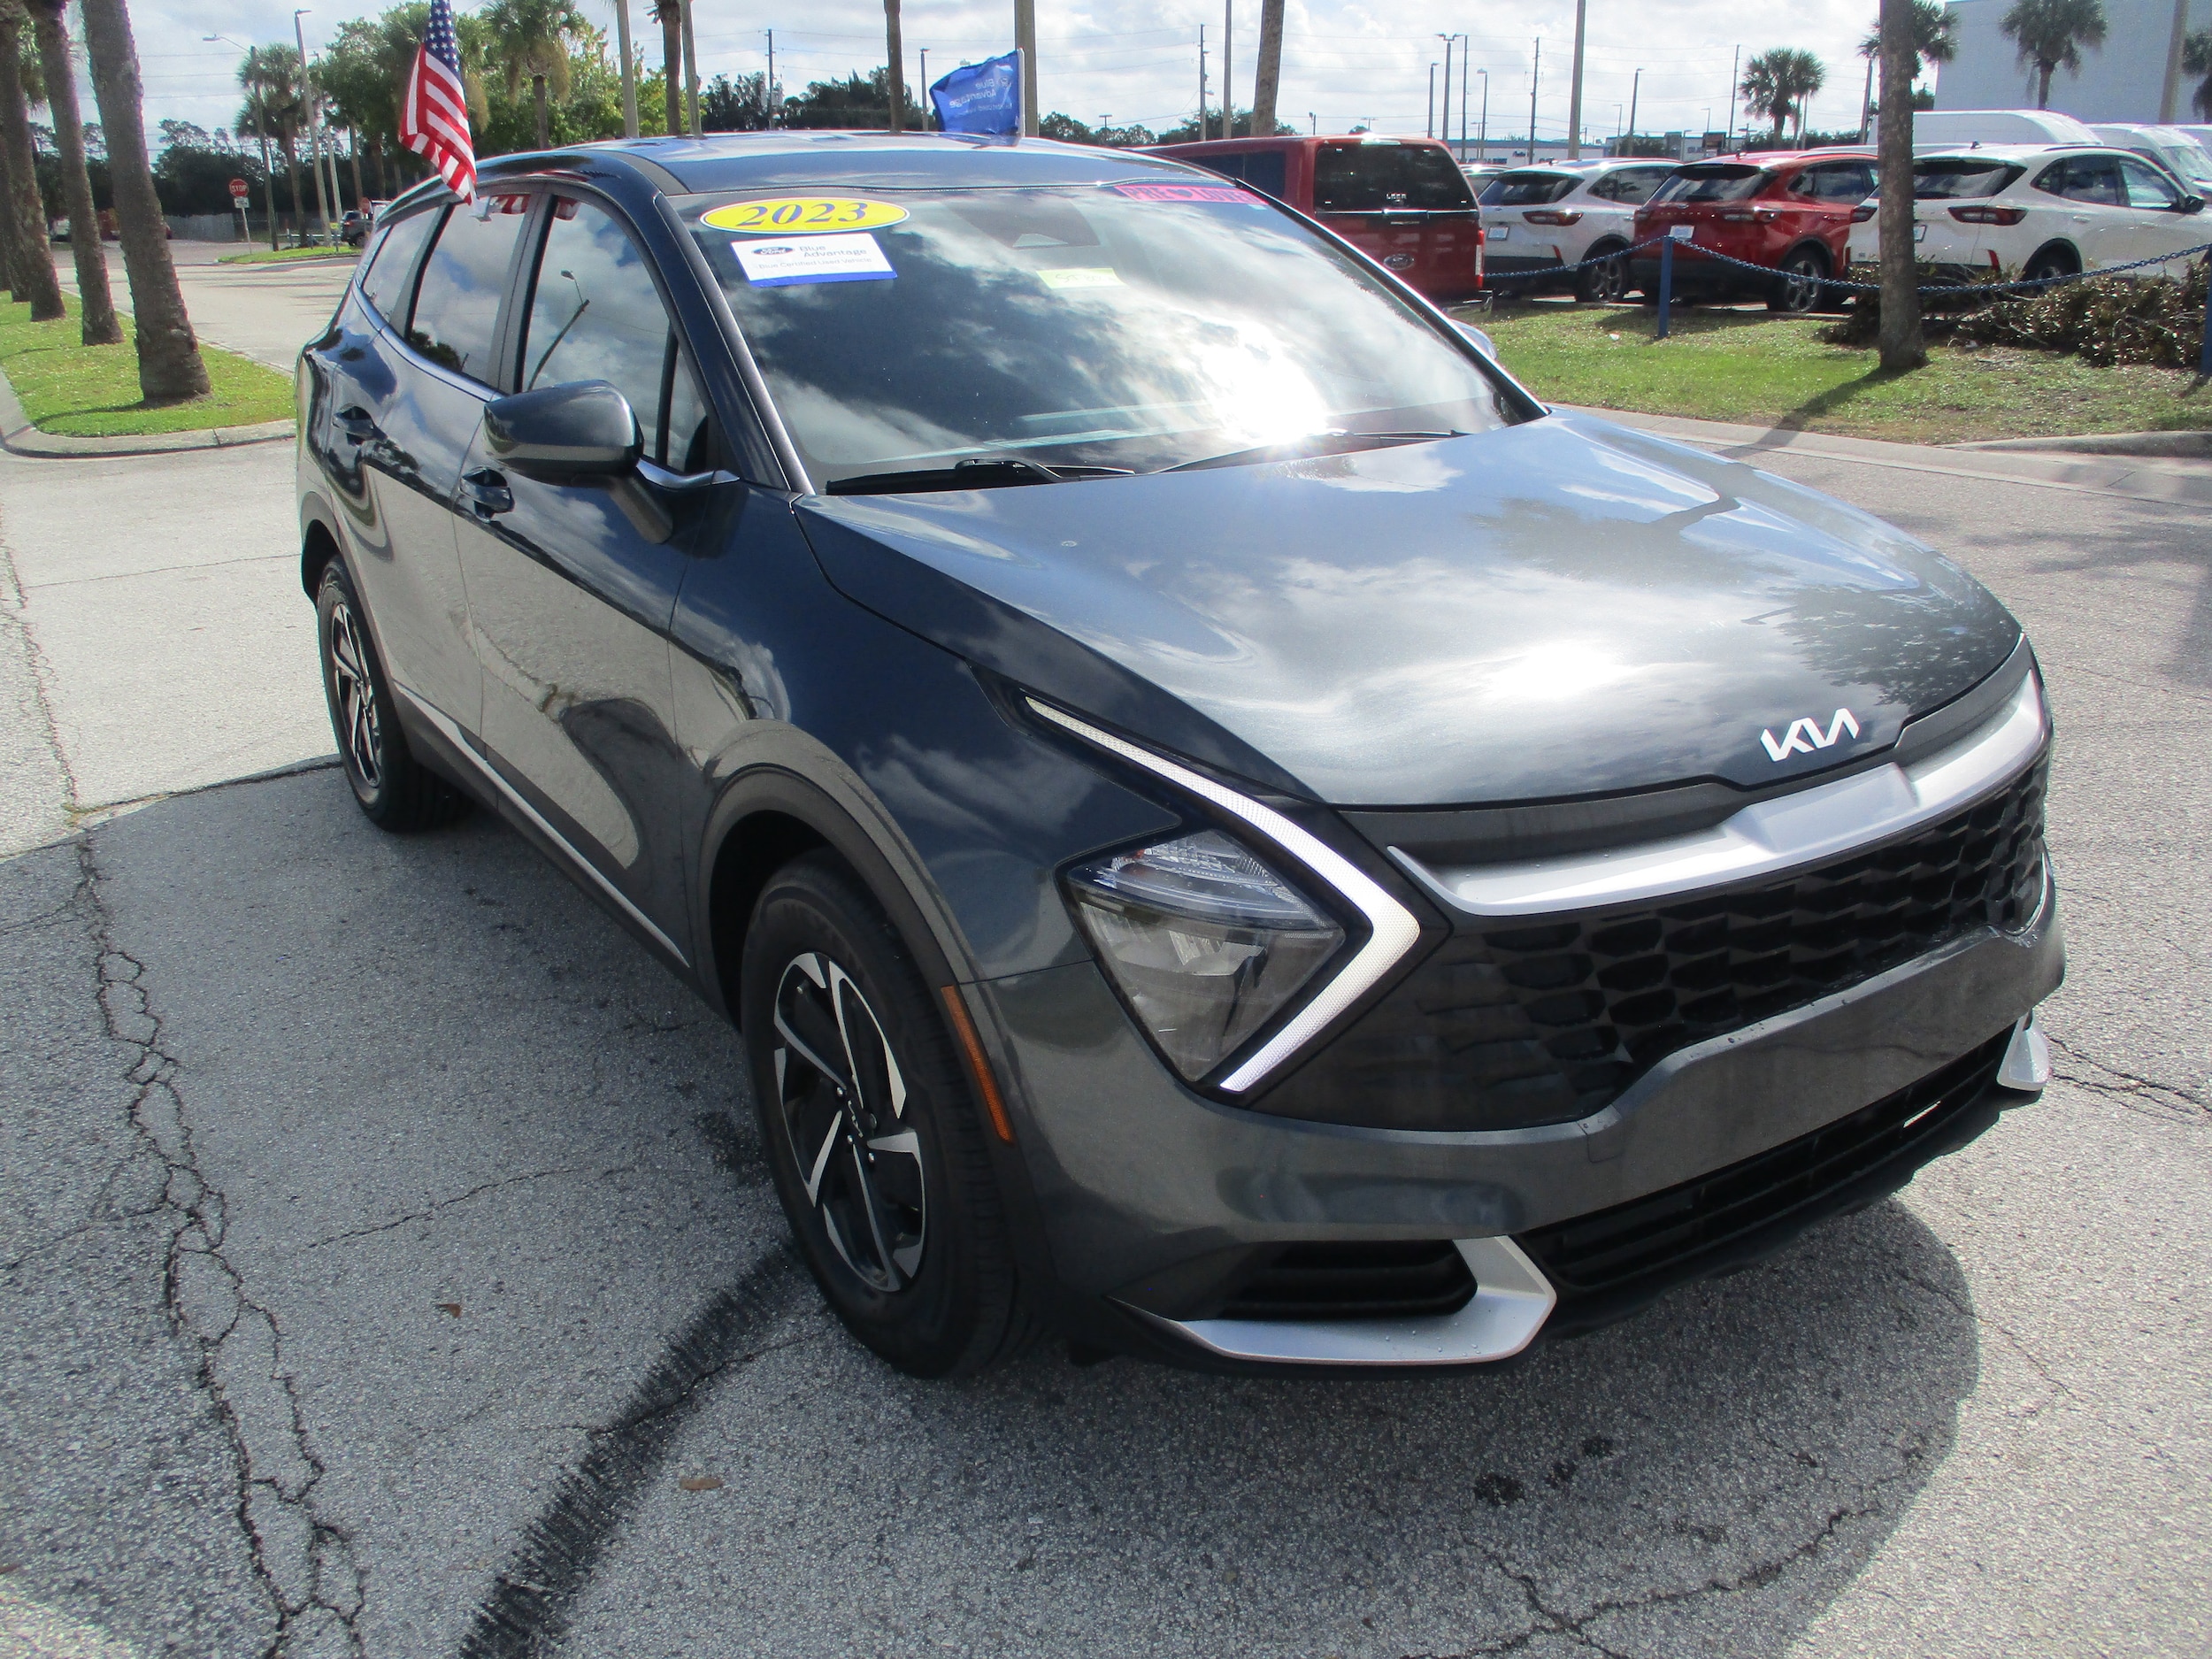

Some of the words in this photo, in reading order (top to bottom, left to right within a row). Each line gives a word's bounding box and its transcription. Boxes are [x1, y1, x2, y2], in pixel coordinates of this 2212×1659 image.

[735, 202, 868, 227] 2023
[803, 249, 867, 258] Advantage
[1760, 707, 1860, 762] KIA
